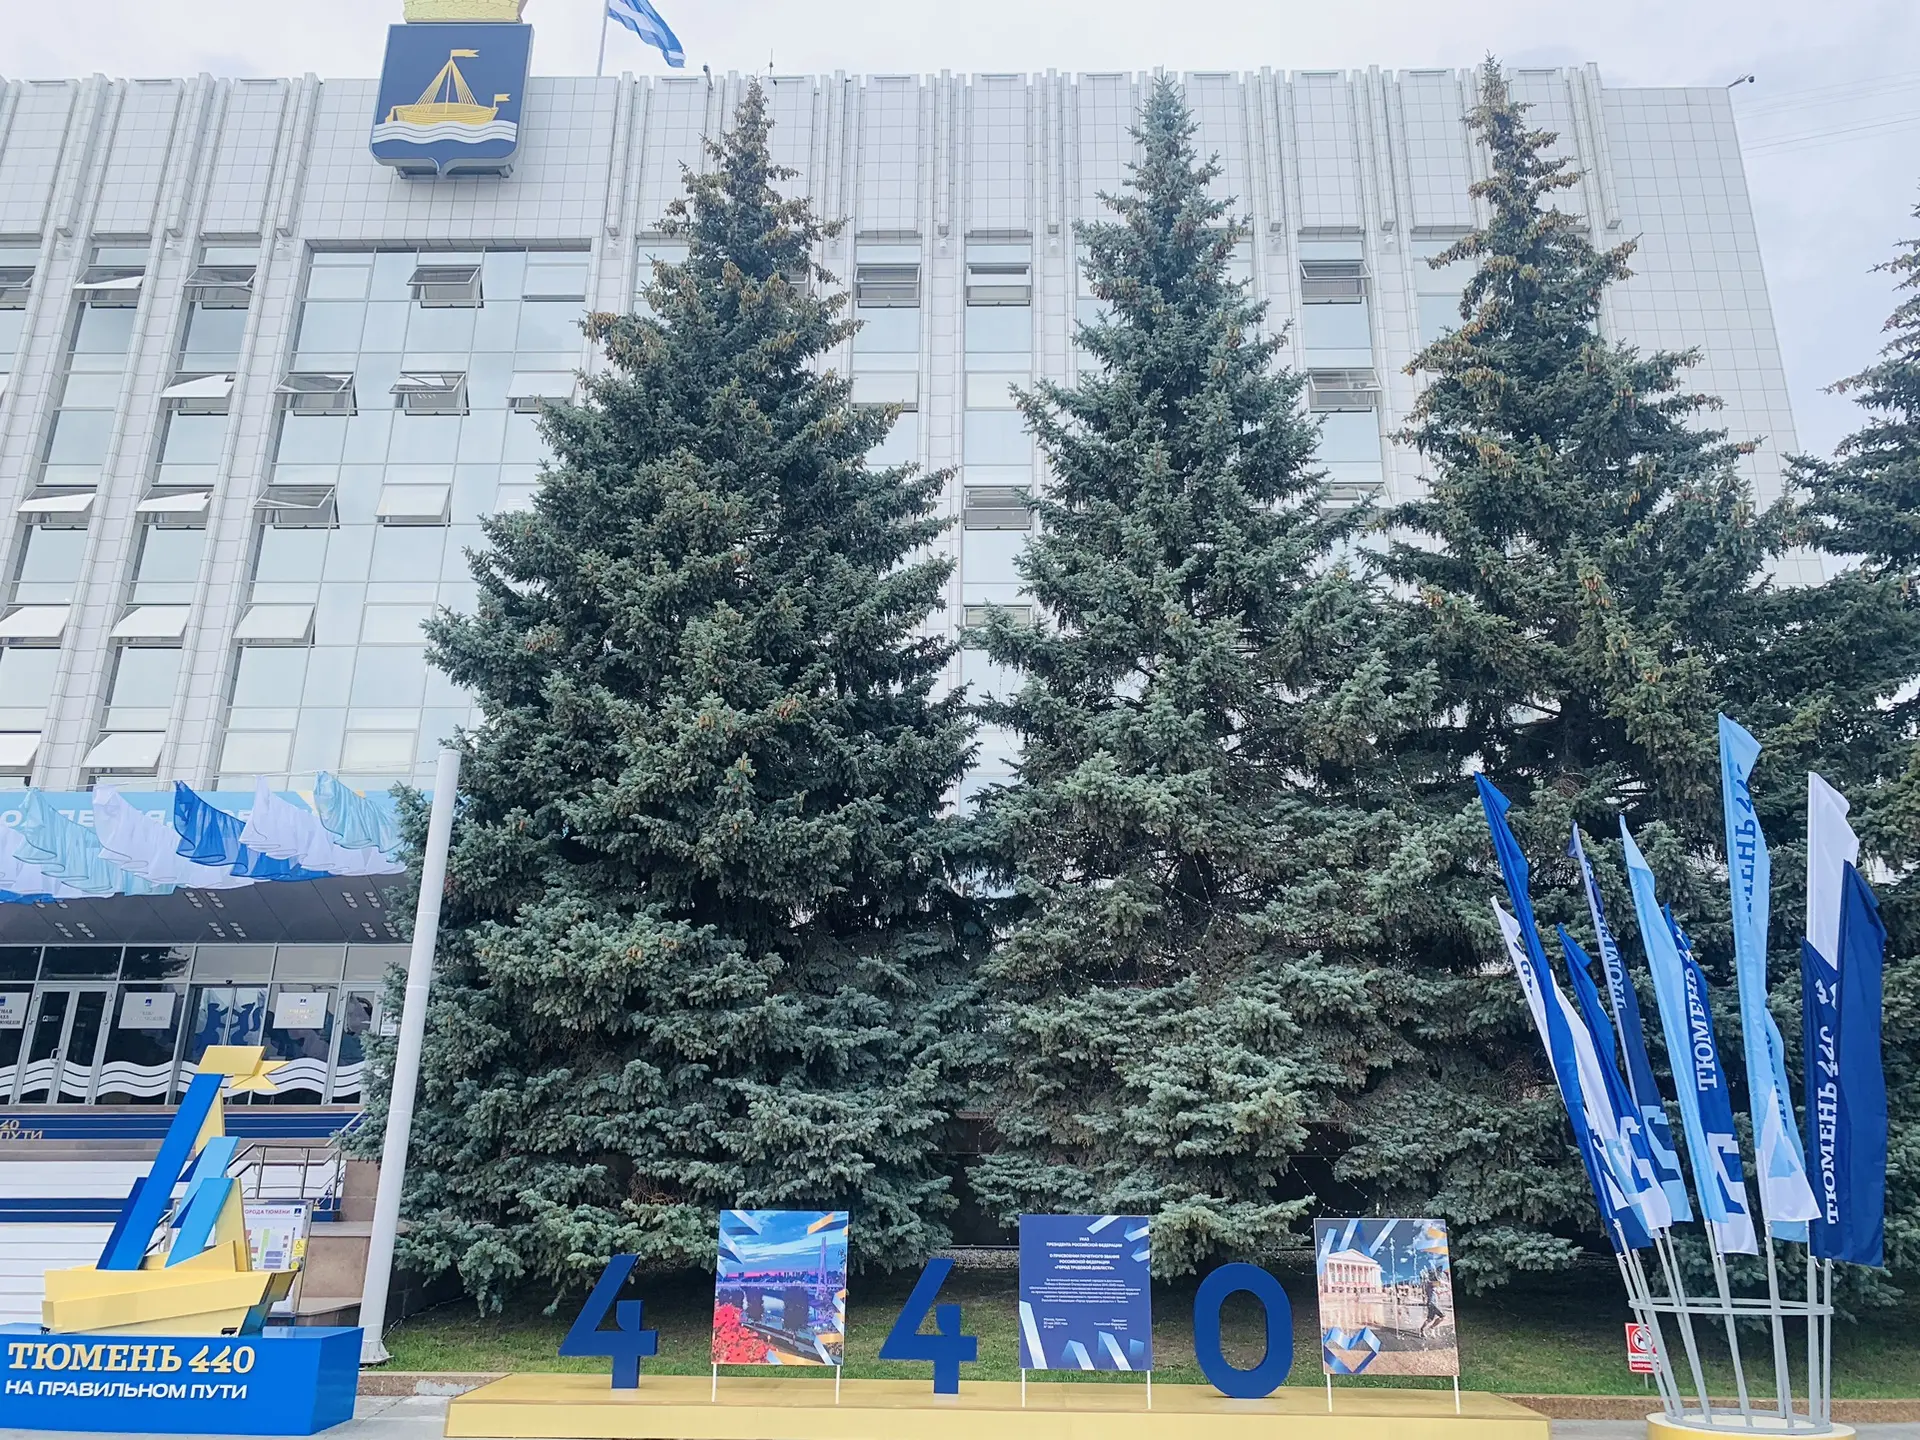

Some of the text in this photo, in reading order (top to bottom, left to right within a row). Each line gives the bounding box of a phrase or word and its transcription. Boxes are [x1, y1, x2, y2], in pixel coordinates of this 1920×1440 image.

[0, 1130, 43, 1140] ПУТИ
[1817, 1082, 1840, 1225] ТЮМЕНЬ
[557, 1253, 1292, 1398] 4 4 0
[7, 1342, 256, 1374] ТЮМЕНЬ 440
[4, 1379, 248, 1400] НА ПРАВИЛЬНОМ ПУТИ
